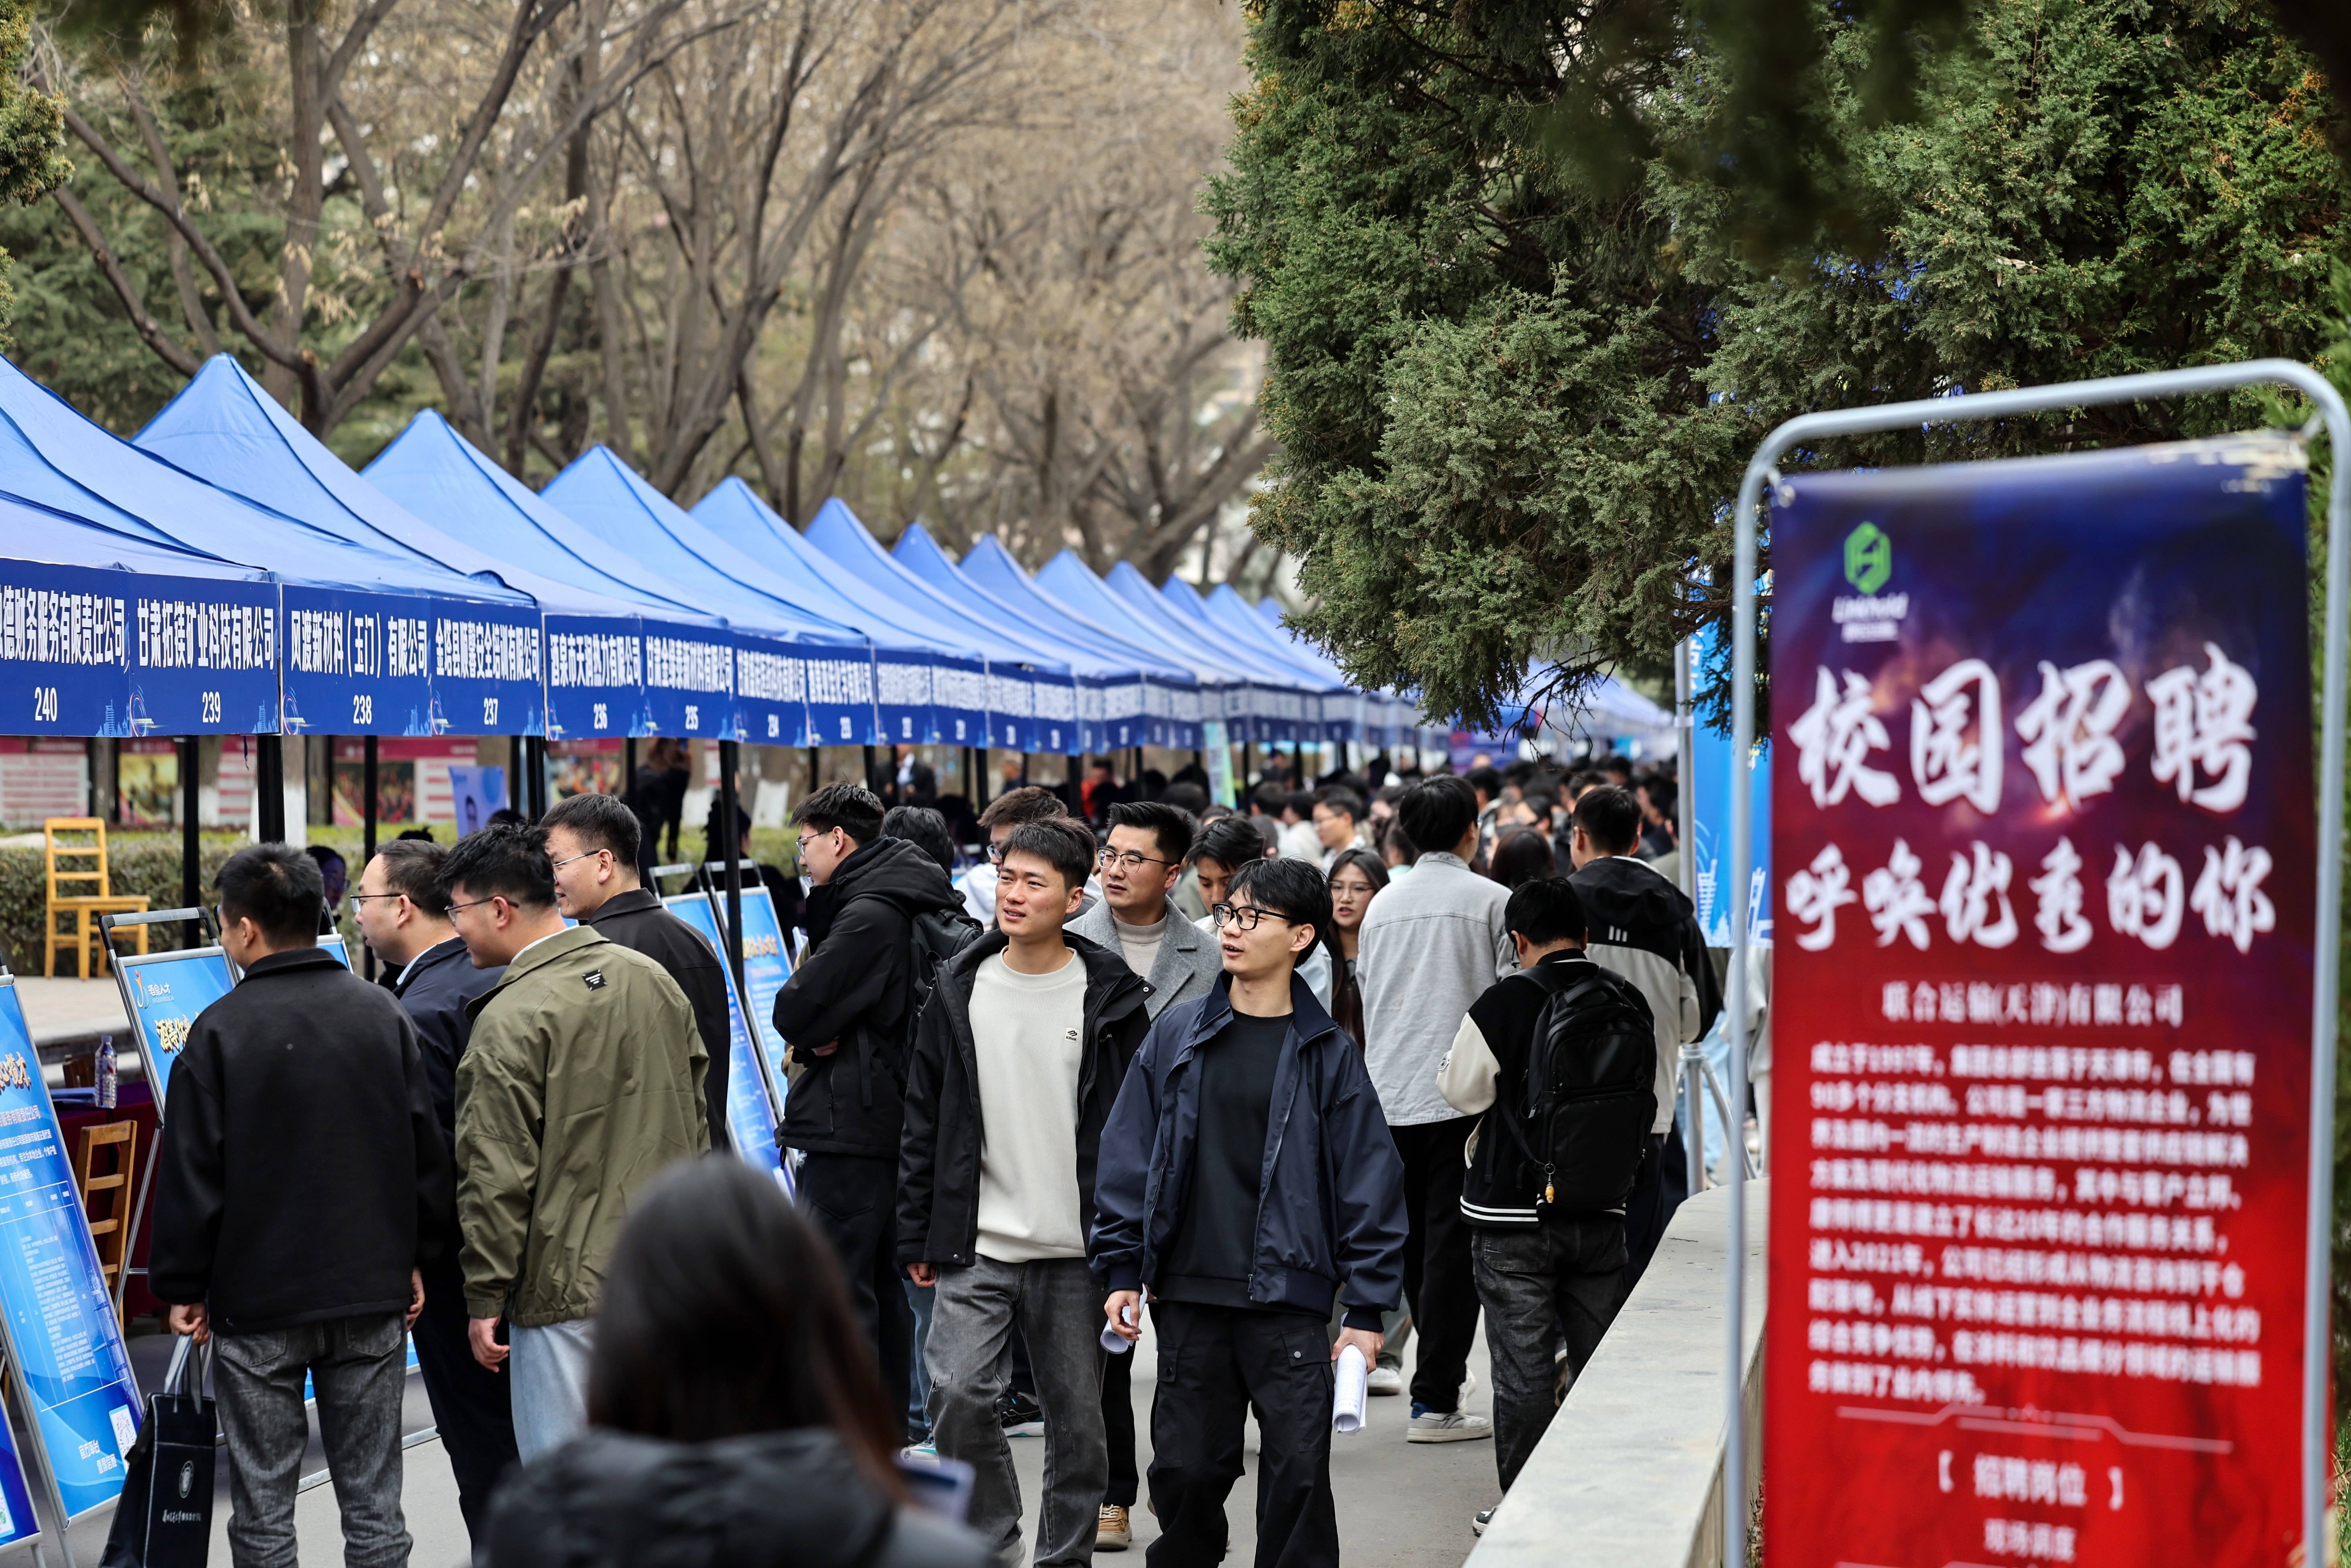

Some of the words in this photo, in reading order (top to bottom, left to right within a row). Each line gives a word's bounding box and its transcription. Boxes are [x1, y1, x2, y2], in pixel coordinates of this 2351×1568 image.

[0, 584, 125, 666] 德财务服务有限责任公司
[137, 598, 274, 670] 甘肃拓镁矿业科技有限公司
[435, 618, 540, 682] 金塔县顺馨安全培训有限公司
[550, 632, 642, 688] 酒泉市天润热力有限公司
[34, 687, 57, 722] 240
[202, 691, 221, 723] 239
[353, 695, 372, 724] 238
[484, 698, 498, 725] 237
[594, 703, 608, 729] 236
[685, 705, 699, 730] 235
[1785, 641, 2258, 814] 校园招聘
[1785, 834, 2276, 954] 呼唤优秀的你
[148, 983, 170, 997] 酒泉人才
[0, 1051, 30, 1090] 心揽才
